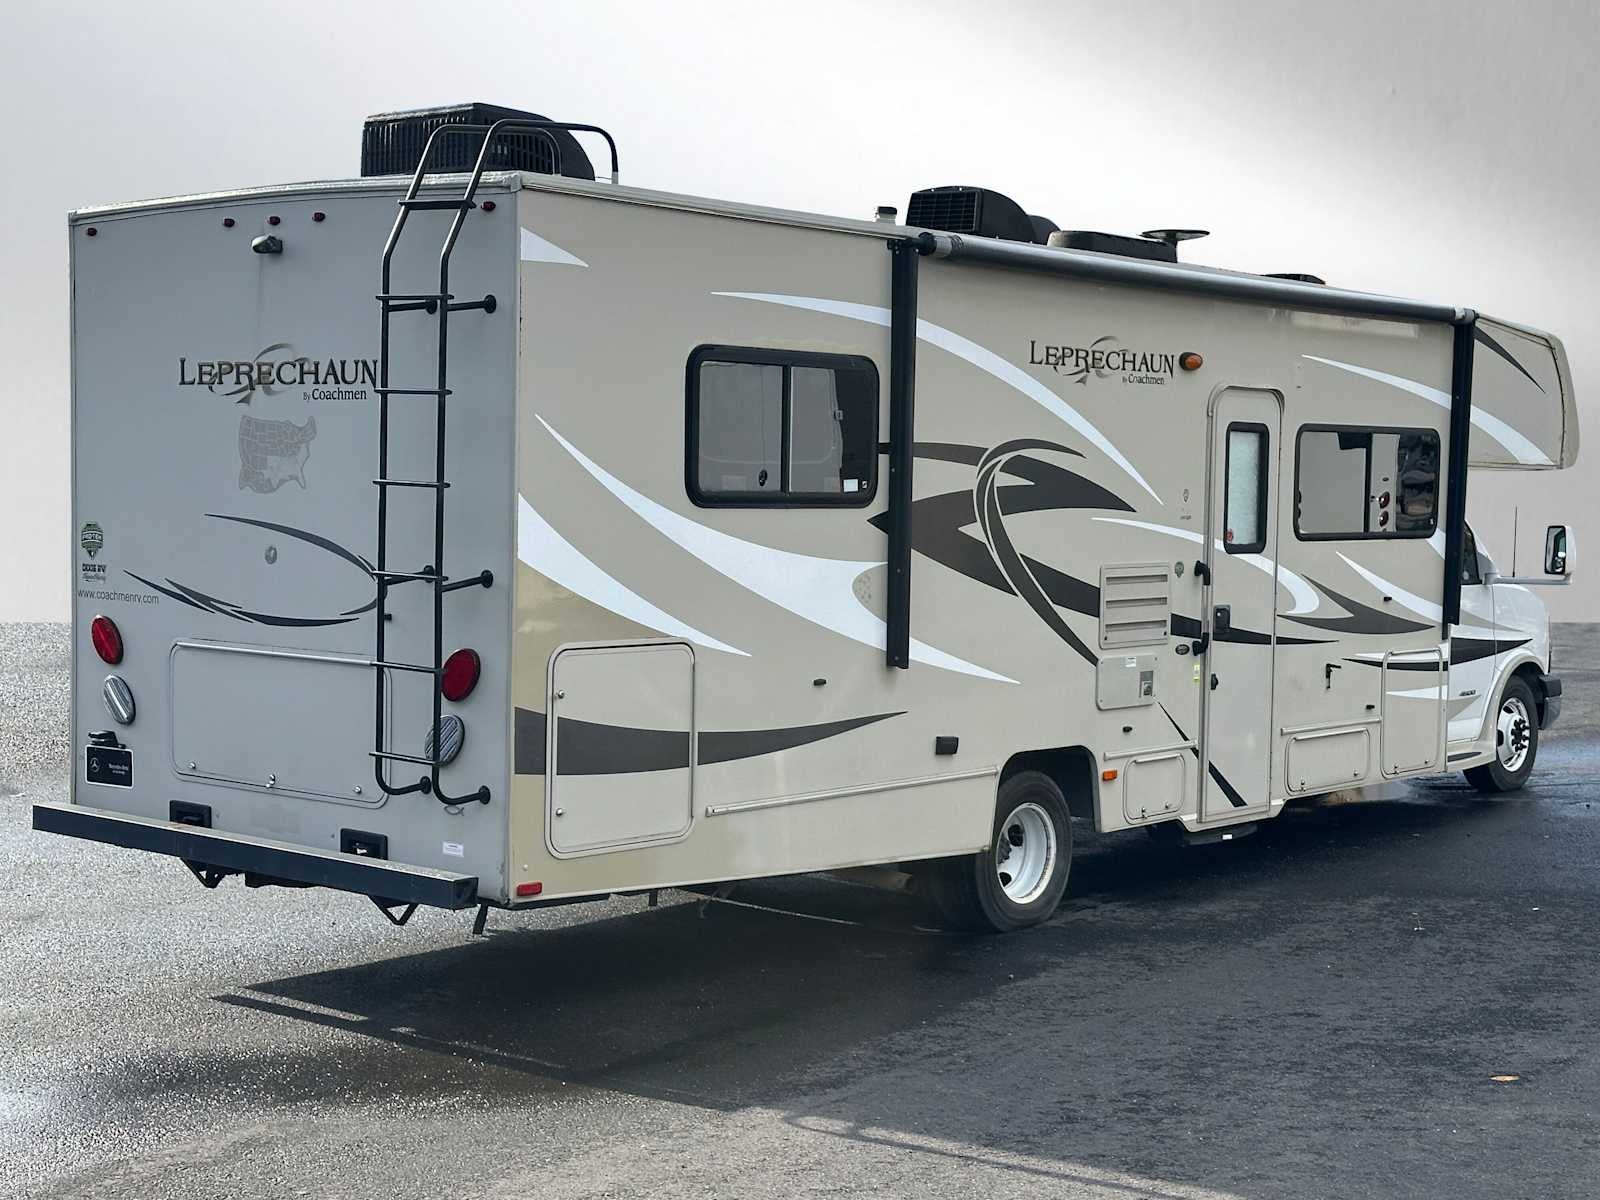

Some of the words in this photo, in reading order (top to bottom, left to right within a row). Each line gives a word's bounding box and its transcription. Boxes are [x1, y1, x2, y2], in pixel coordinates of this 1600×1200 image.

[1029, 339, 1175, 379] LEPRECHAUN
[178, 357, 378, 390] LEPRECHAUN
[1128, 373, 1165, 385] Coachmen
[303, 391, 311, 402] By
[311, 388, 368, 401] Coachmen
[78, 588, 160, 605] www.coachmenrv.com
